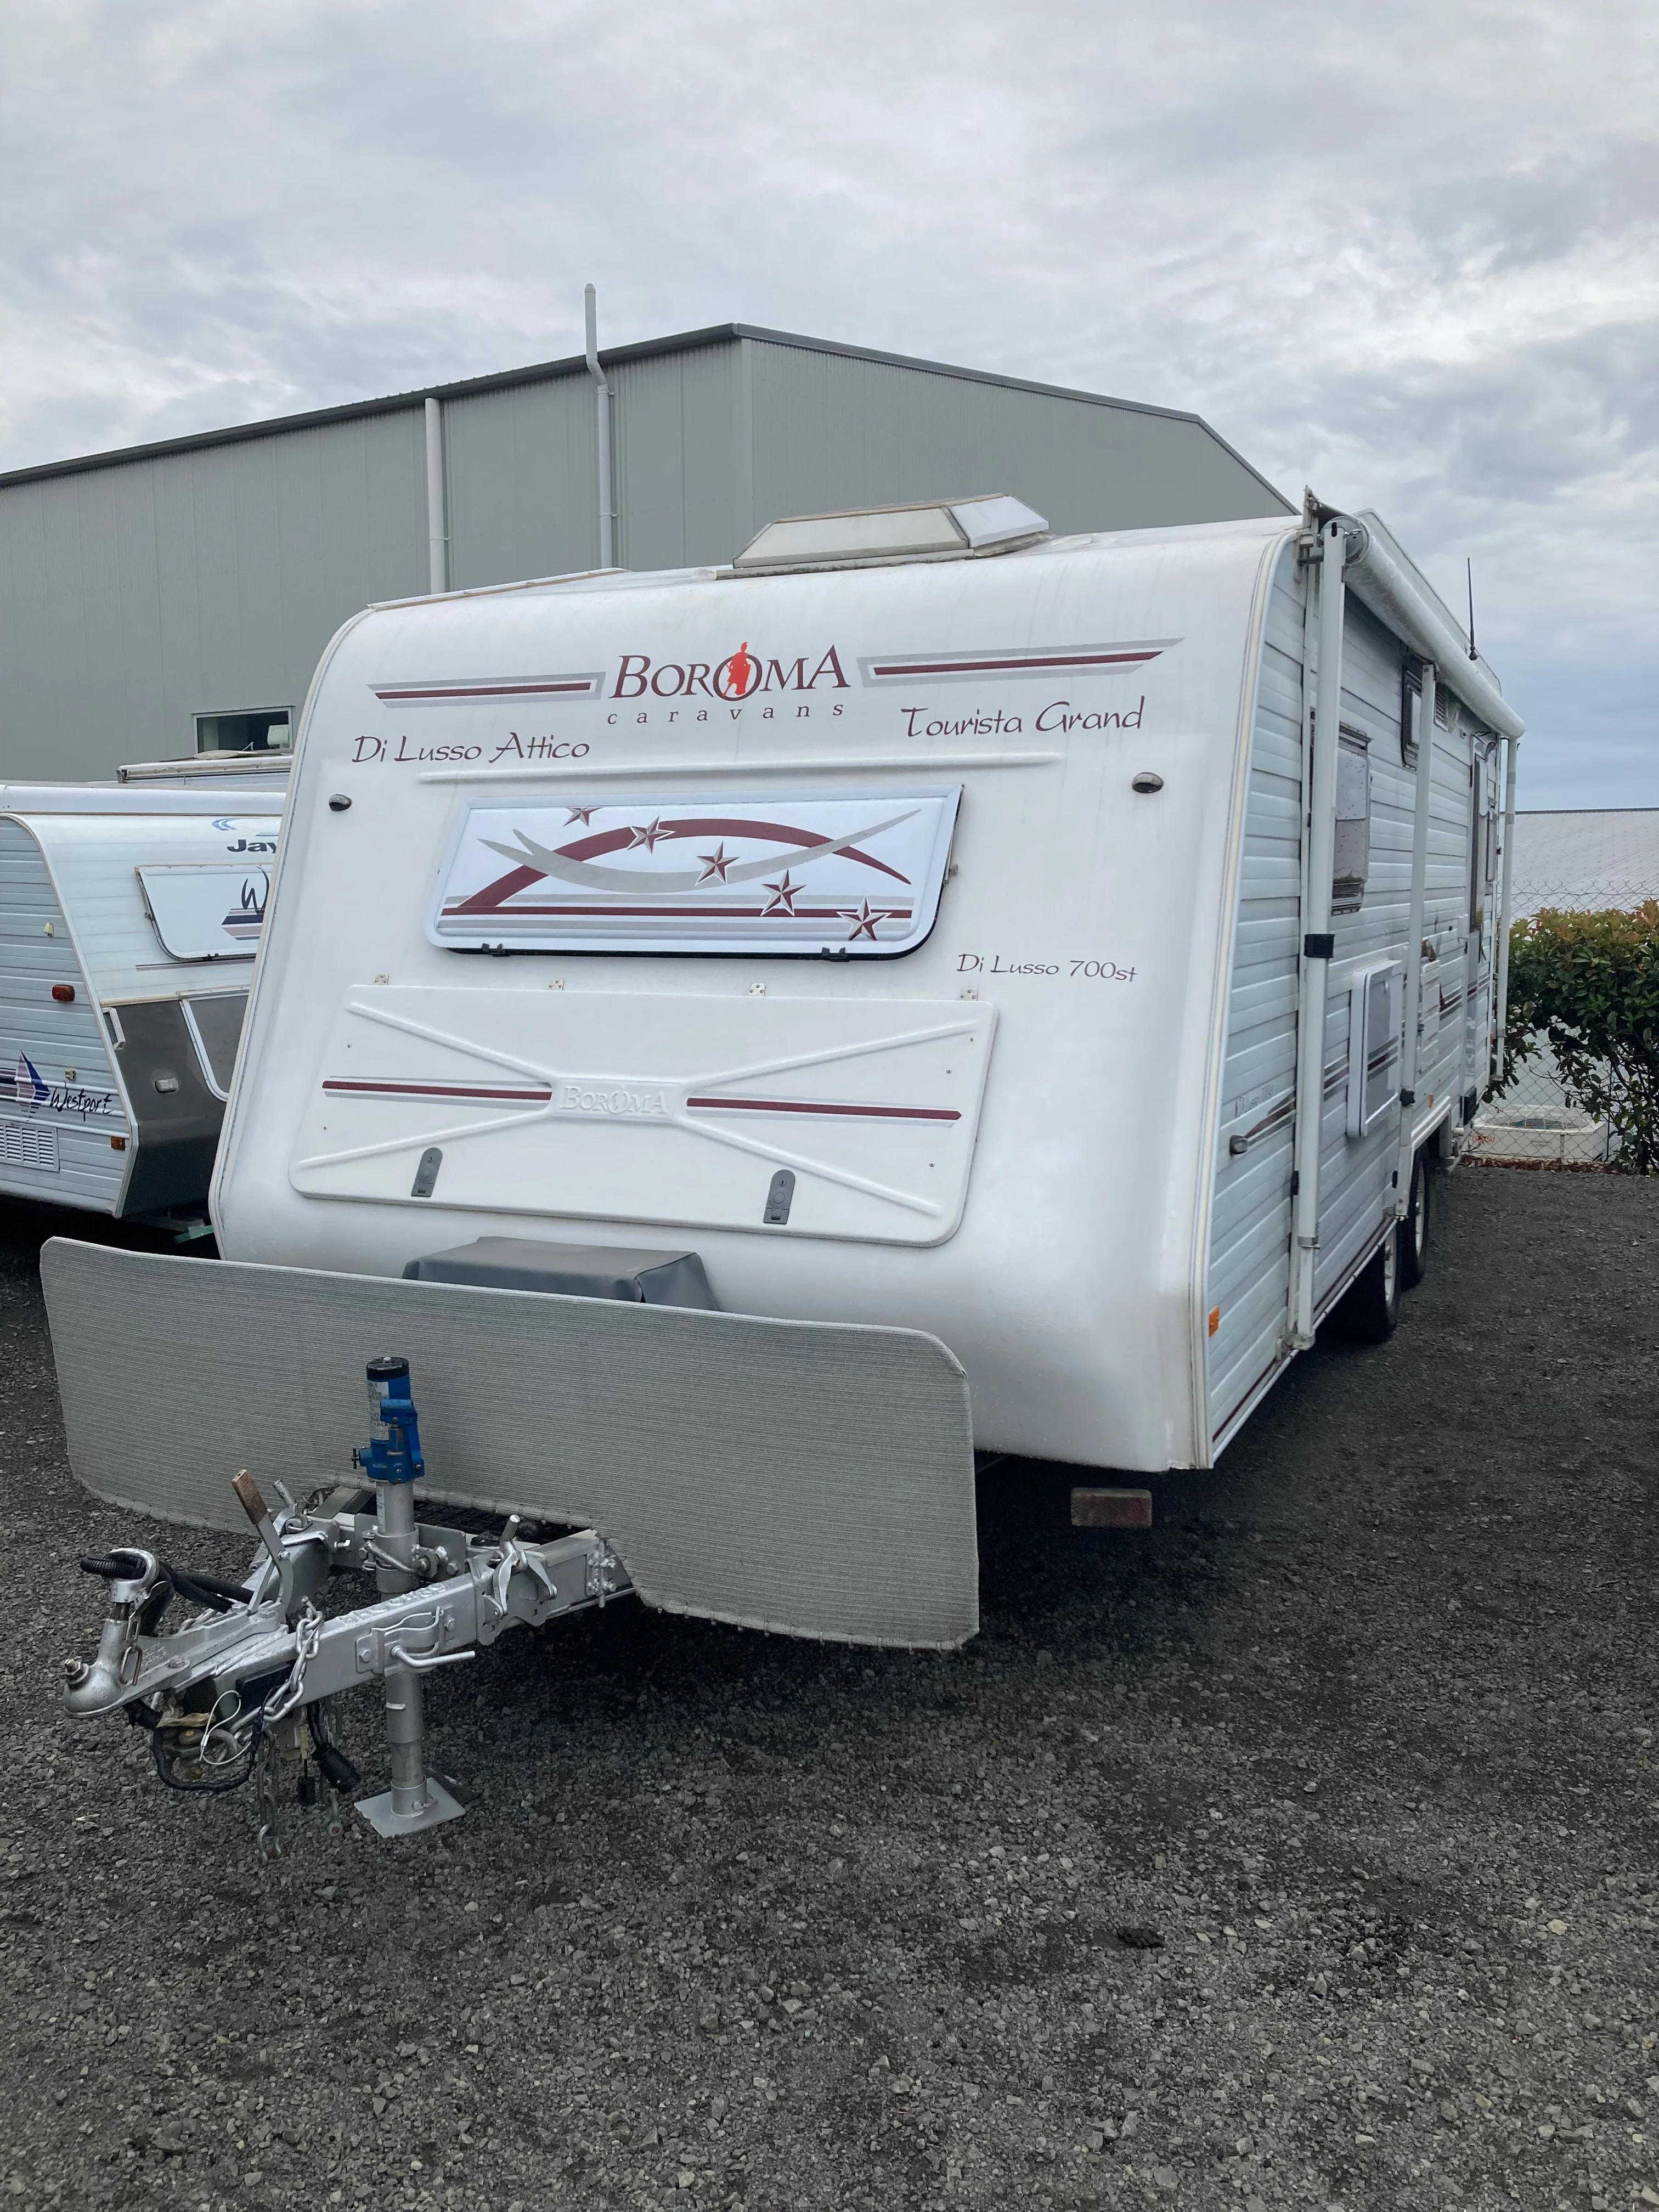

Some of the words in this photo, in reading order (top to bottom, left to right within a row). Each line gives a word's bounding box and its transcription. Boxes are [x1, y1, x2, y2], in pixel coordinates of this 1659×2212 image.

[608, 644, 851, 701] BOROMA
[607, 703, 844, 725] caravans
[900, 706, 1023, 737] Tourista
[1035, 695, 1145, 733] Grand
[352, 735, 387, 763] Di
[394, 735, 482, 762] Lusso
[488, 731, 590, 764] Attico
[956, 953, 985, 973] Di
[990, 955, 1060, 975] Lusso
[1069, 960, 1139, 983] 700st
[49, 1080, 114, 1123] Westport
[558, 1085, 668, 1115] BOROMA
